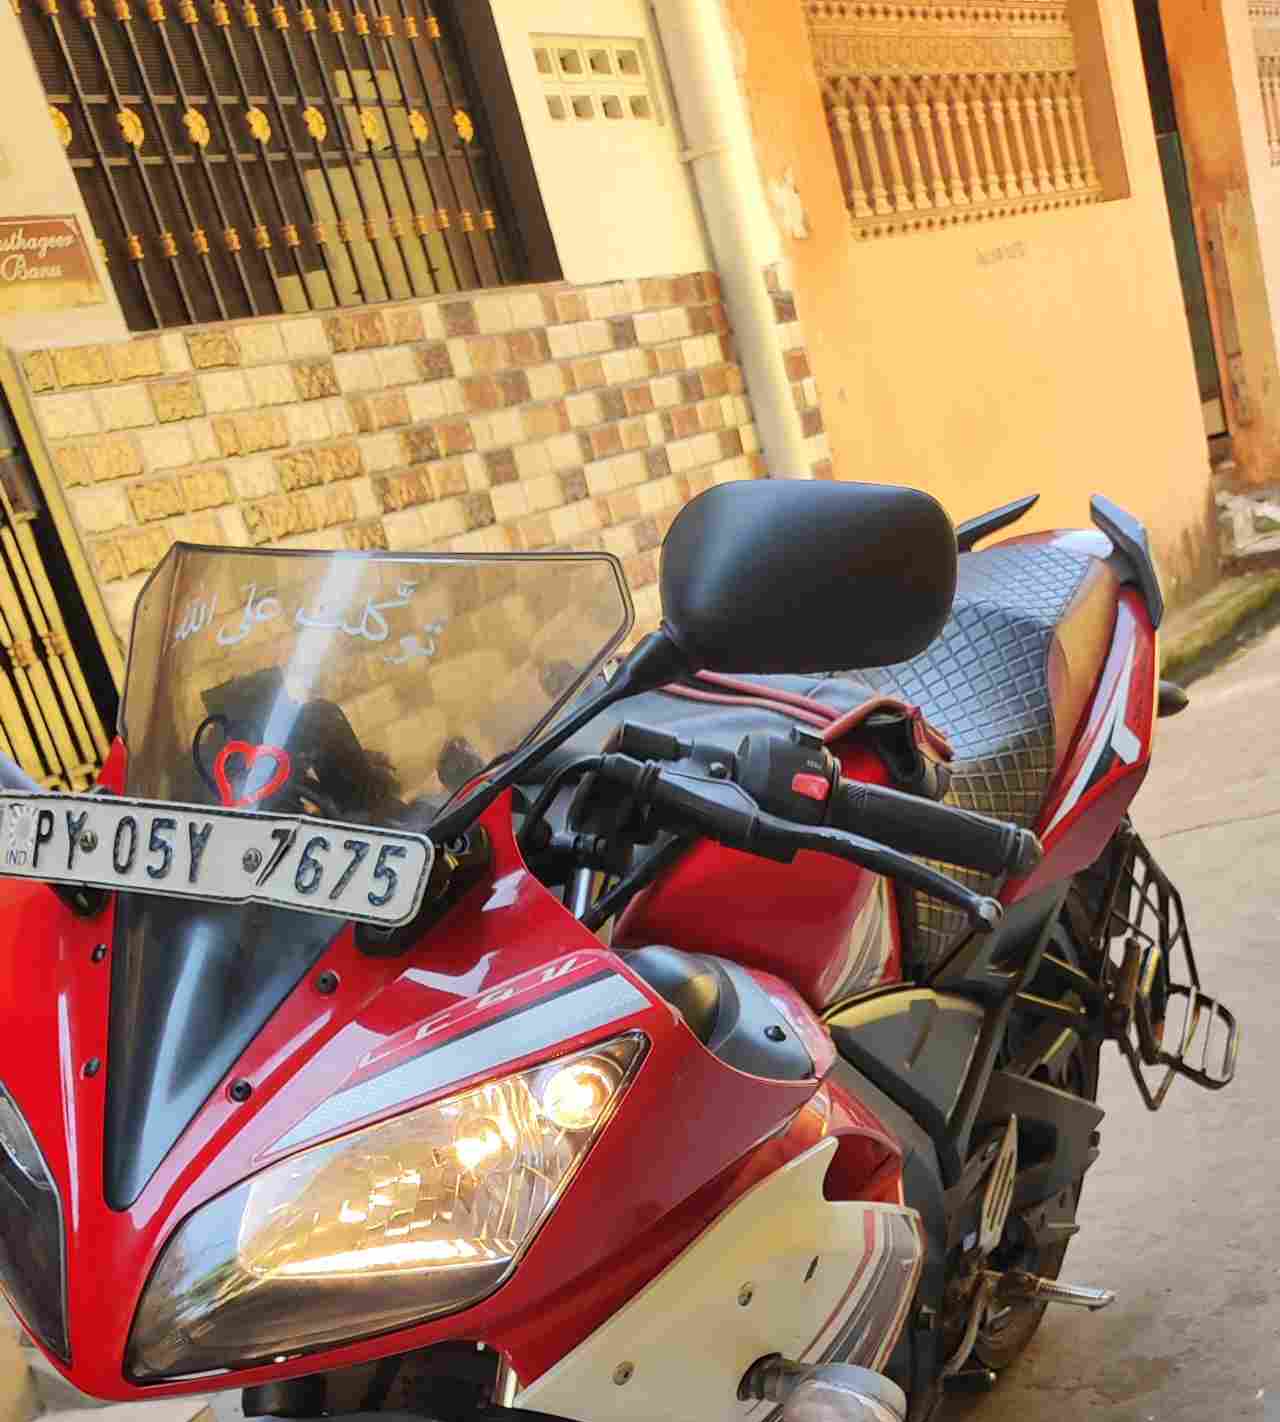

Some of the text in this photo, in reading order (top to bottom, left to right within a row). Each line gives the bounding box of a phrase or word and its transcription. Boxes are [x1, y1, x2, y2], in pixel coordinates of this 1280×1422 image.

[0, 227, 78, 258] sthageer
[32, 809, 408, 907] PY 05Y 7675
